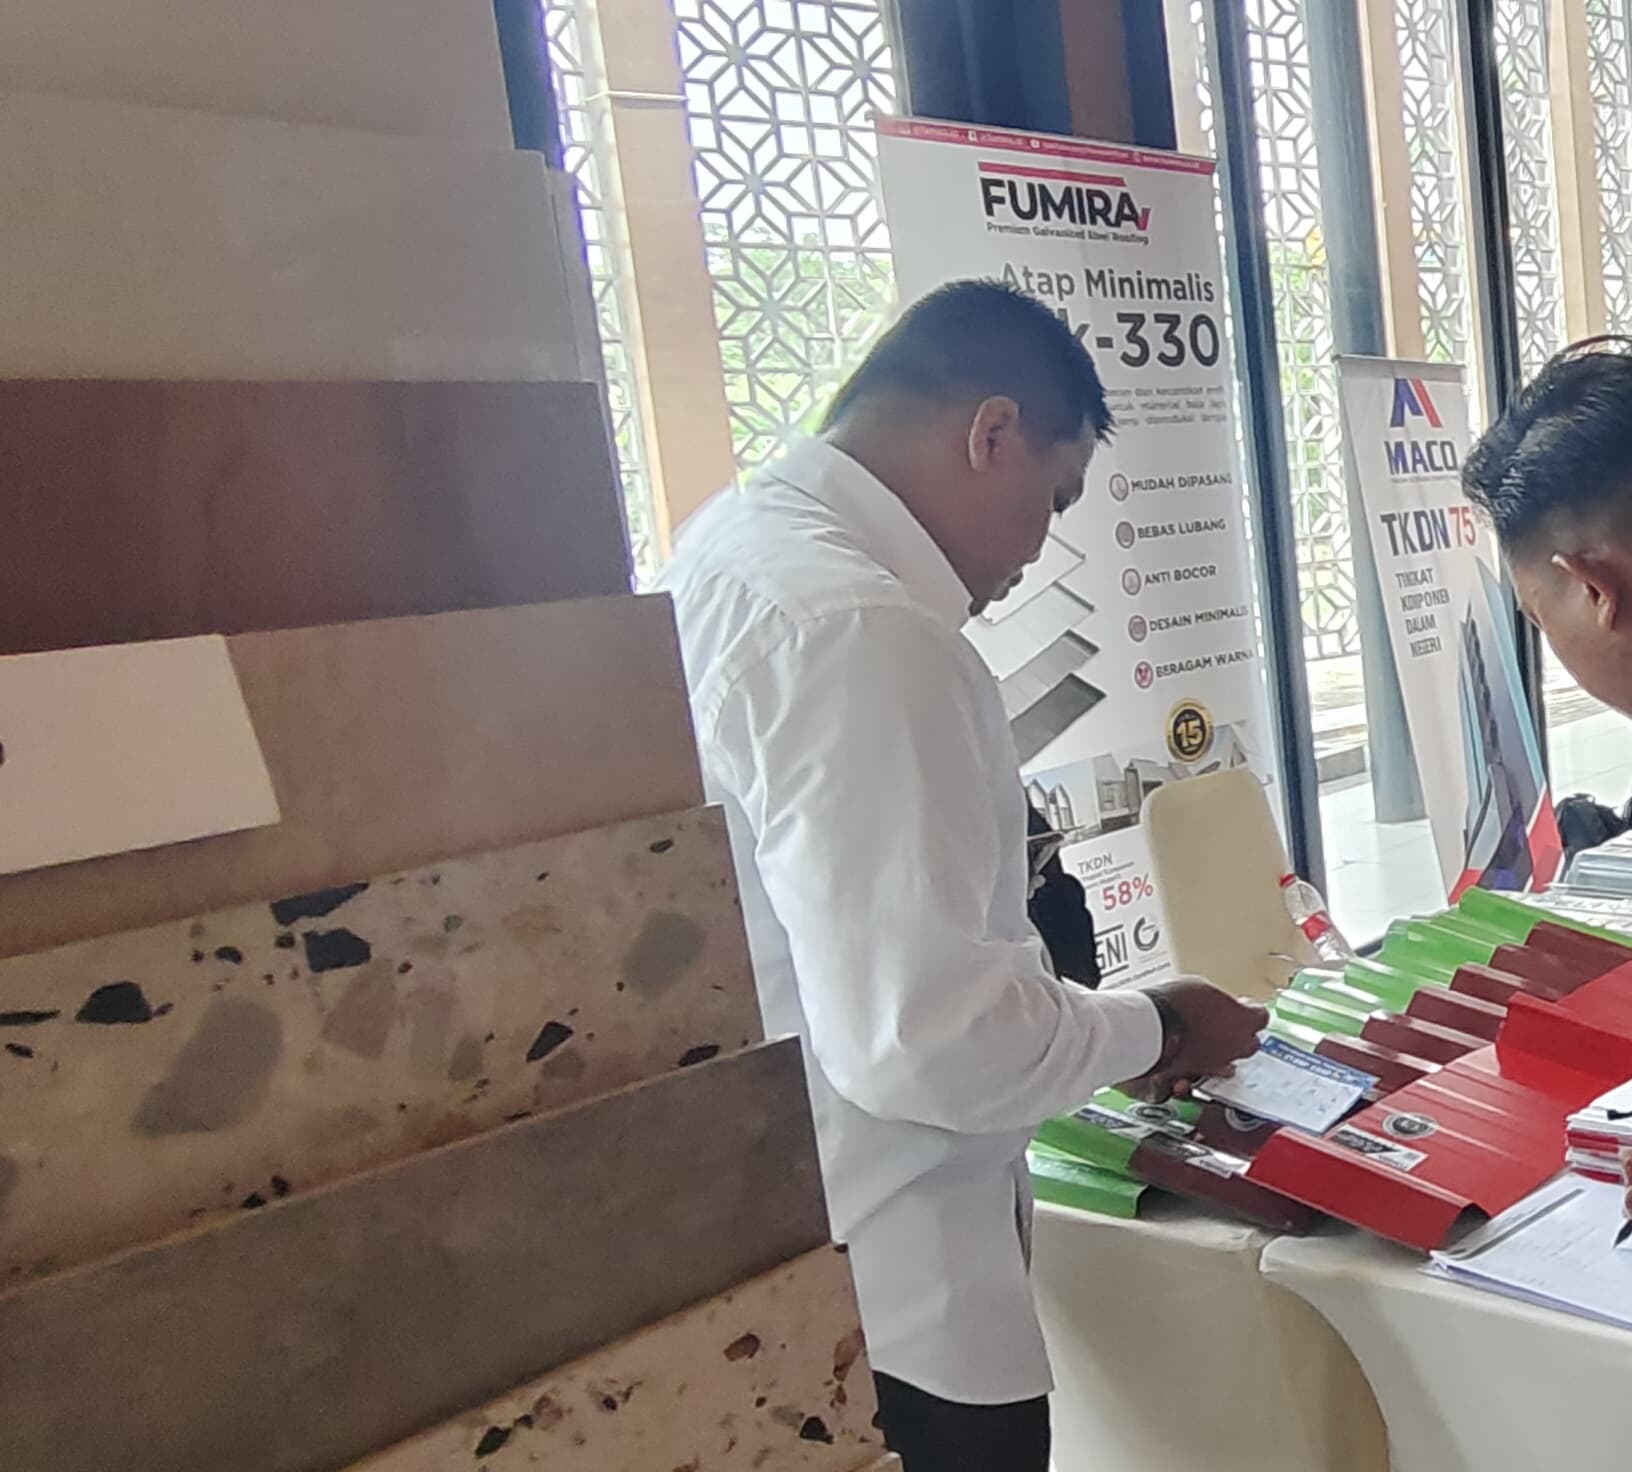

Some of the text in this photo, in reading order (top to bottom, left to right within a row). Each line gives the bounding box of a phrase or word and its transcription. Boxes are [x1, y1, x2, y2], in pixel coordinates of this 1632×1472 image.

[979, 177, 1141, 229] FUMIRA
[1001, 263, 1215, 302] Atap Minimalis
[1131, 476, 1175, 492] MUDAH
[1137, 518, 1226, 539] BEBAS LUBANG
[1380, 508, 1451, 557] TKDN
[1144, 565, 1217, 586] ANTI BOCOR
[1150, 614, 1192, 632] DESAIN
[1156, 656, 1213, 678] BERAGAM
[1077, 851, 1113, 875] TKDN
[1102, 872, 1154, 911] 58%
